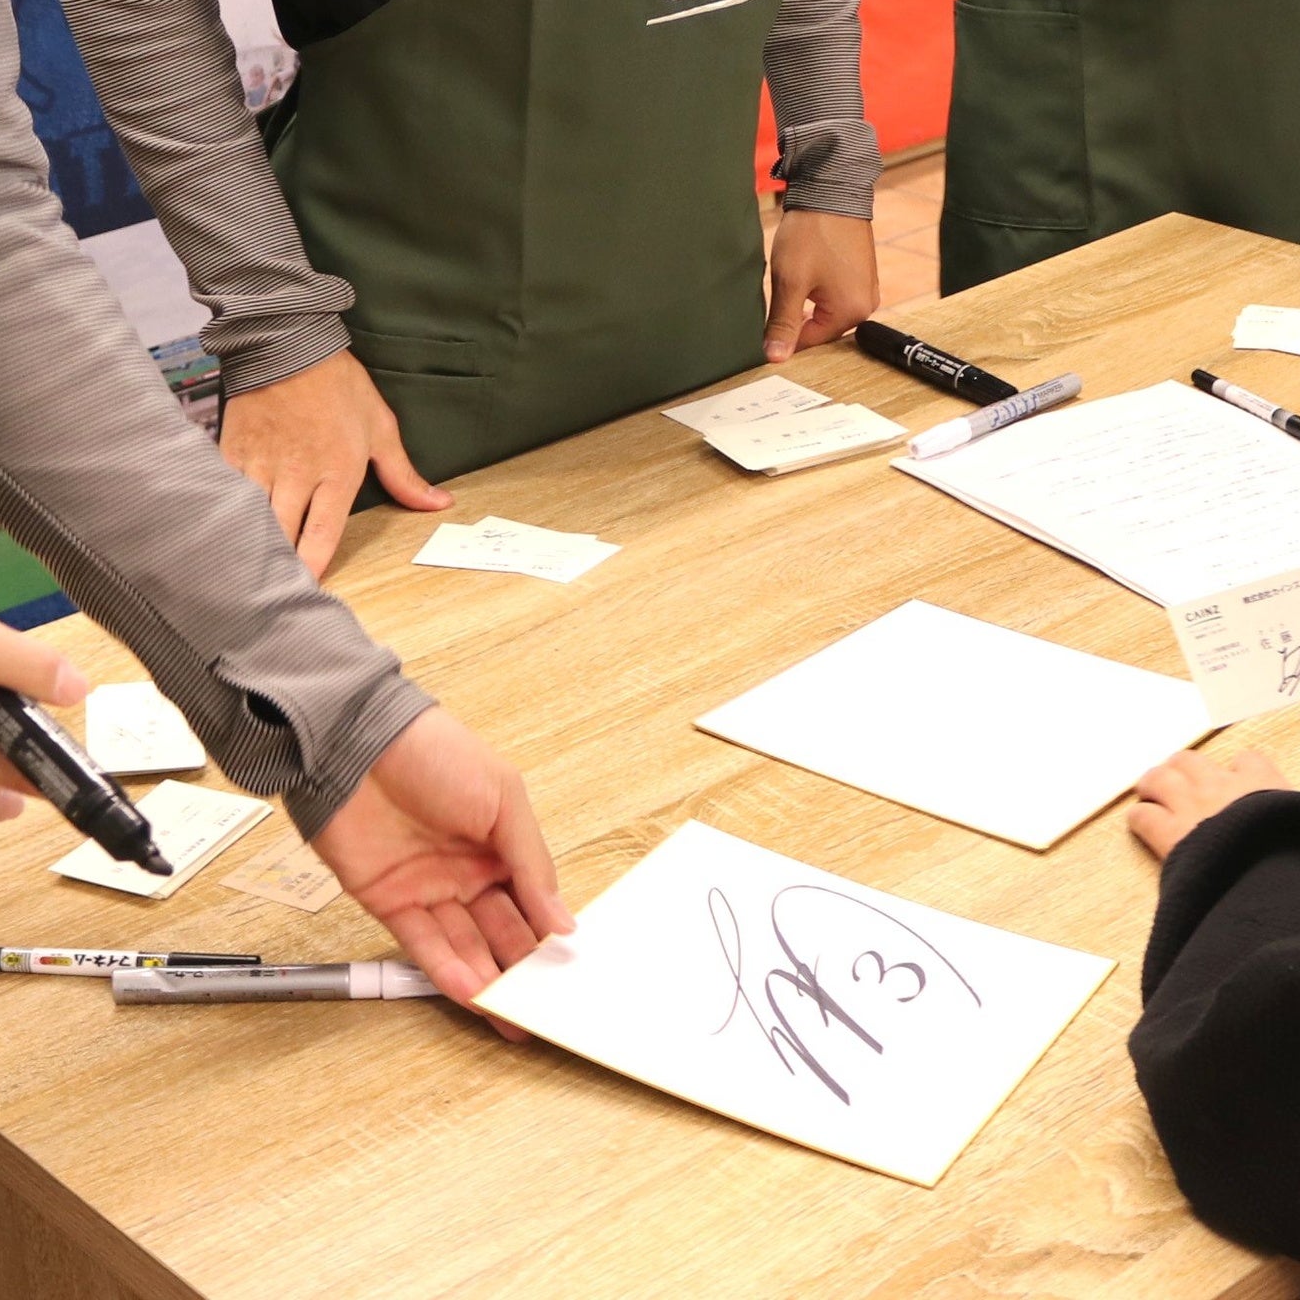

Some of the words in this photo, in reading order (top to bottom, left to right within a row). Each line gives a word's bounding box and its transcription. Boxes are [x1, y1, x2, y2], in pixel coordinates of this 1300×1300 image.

[1185, 605, 1221, 622] CAINZ
[74, 953, 131, 967] マイネーム
[853, 950, 926, 1002] 3
